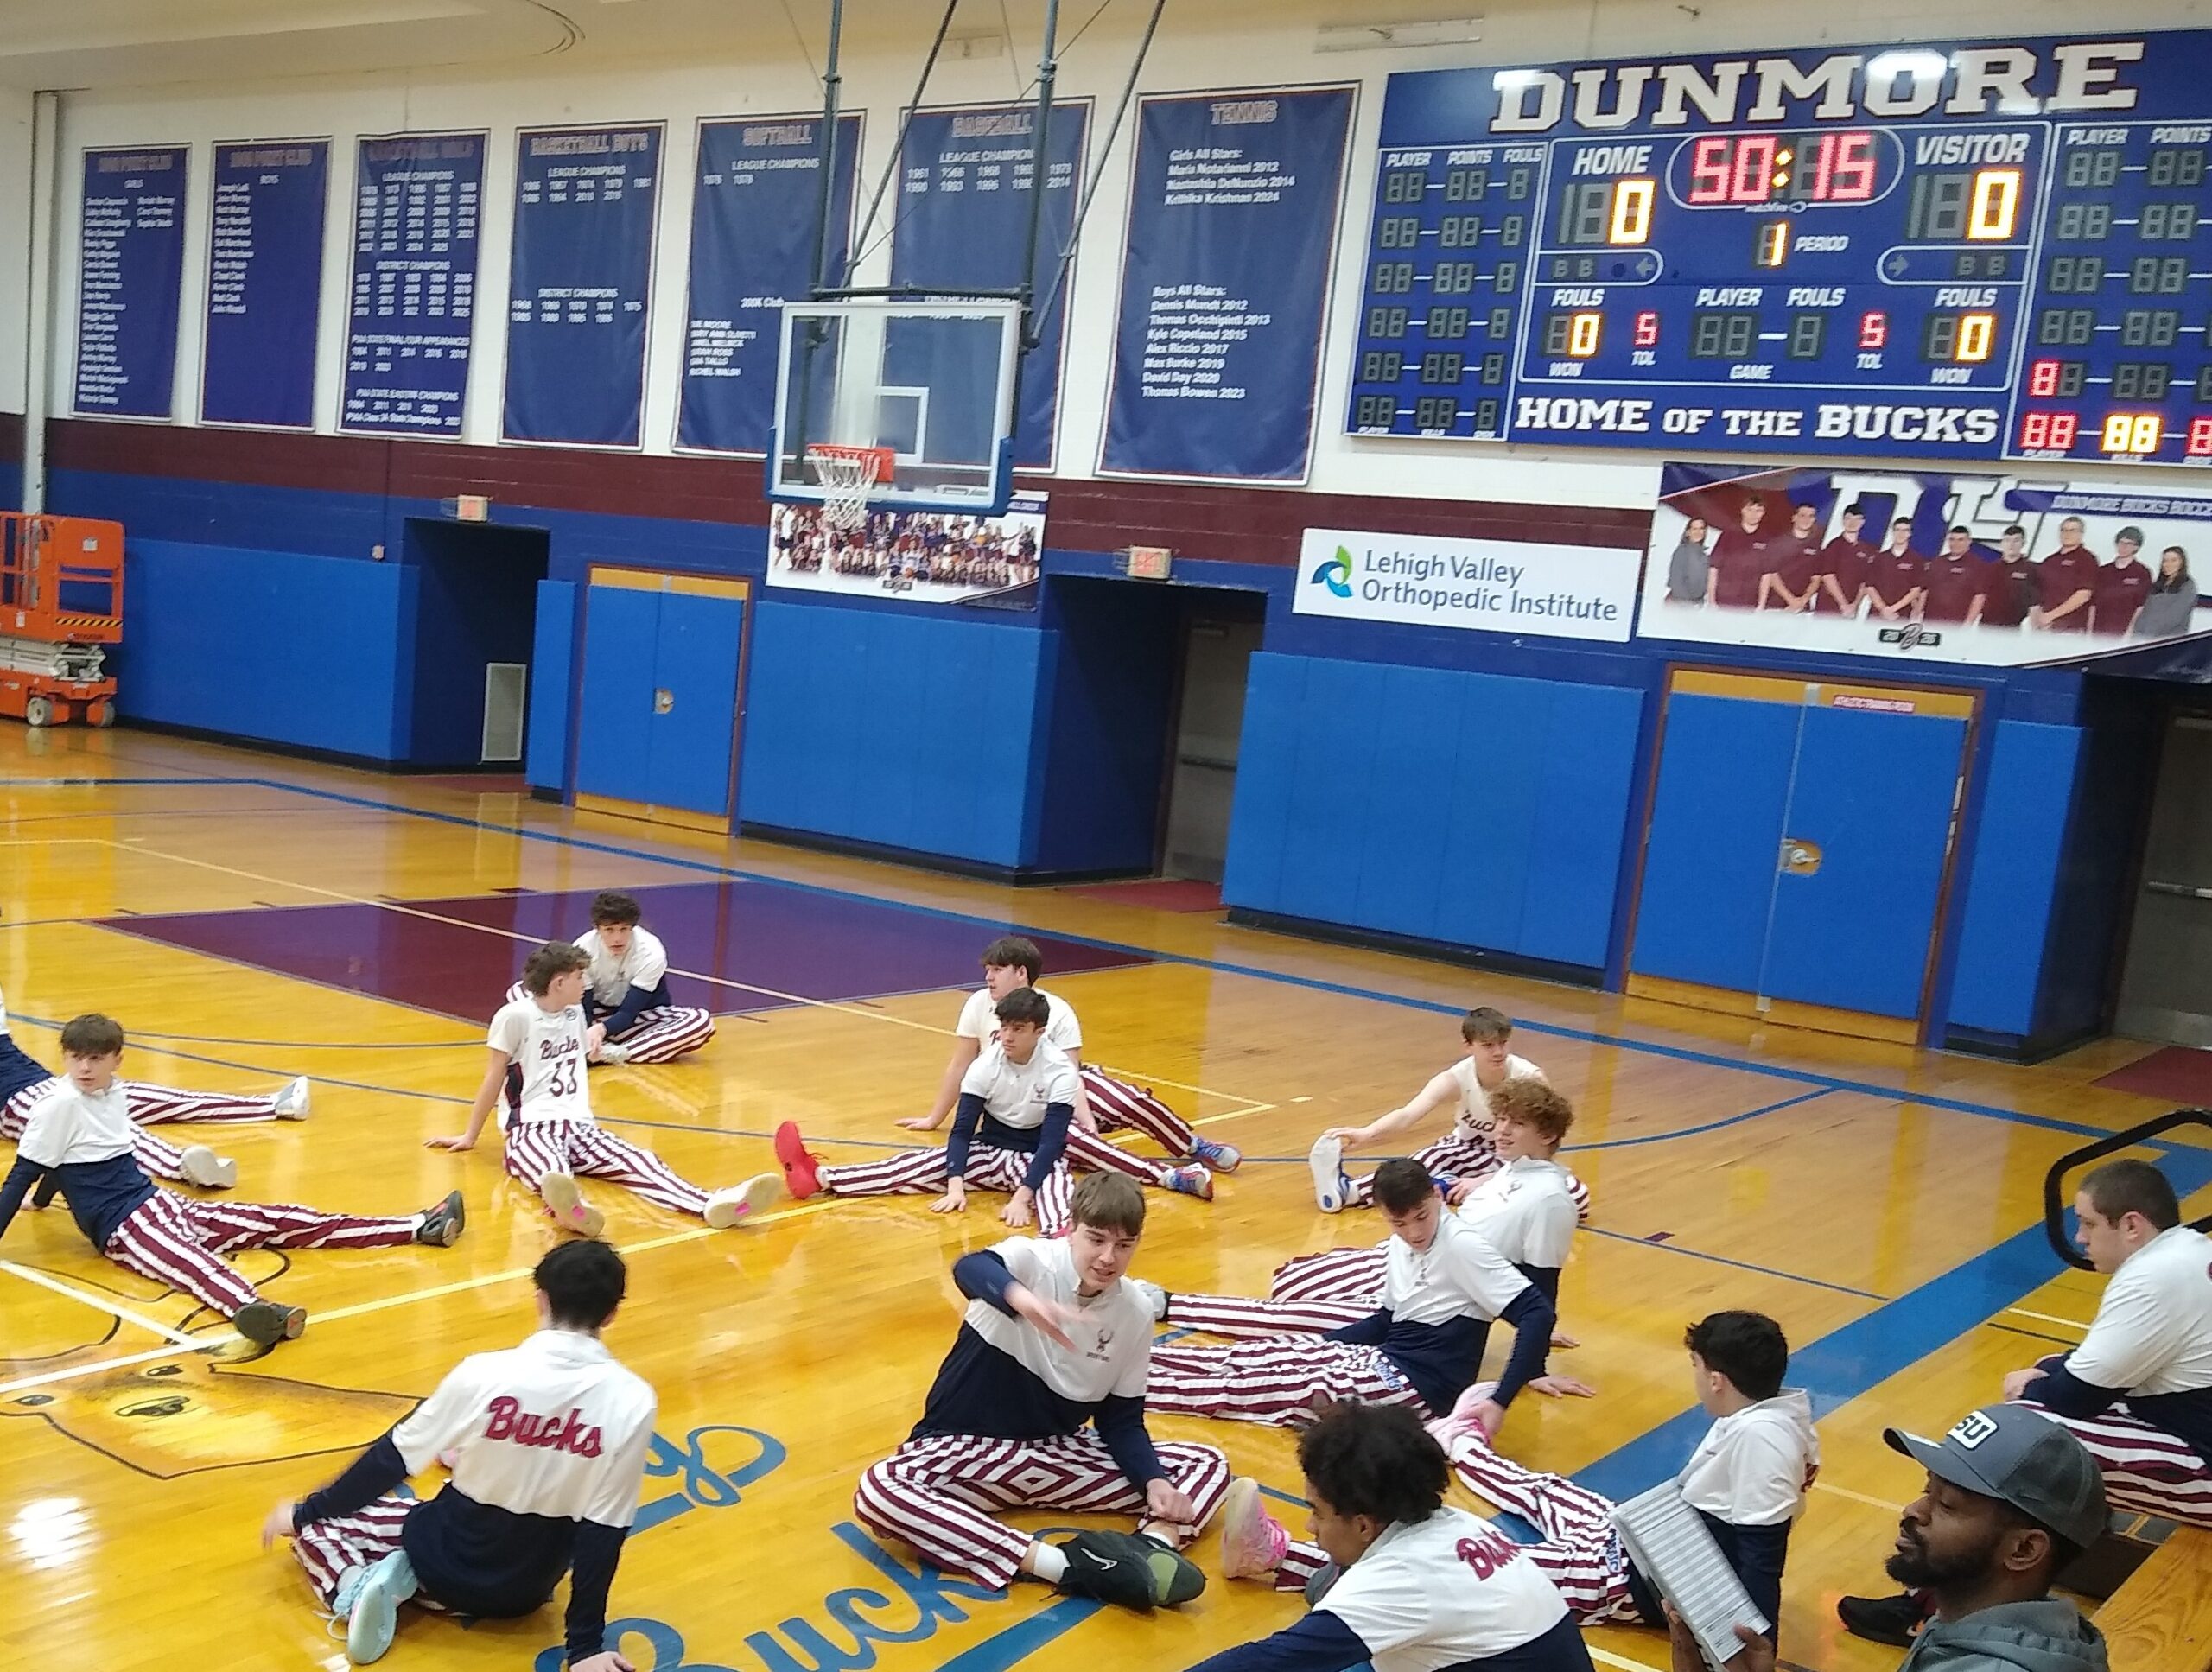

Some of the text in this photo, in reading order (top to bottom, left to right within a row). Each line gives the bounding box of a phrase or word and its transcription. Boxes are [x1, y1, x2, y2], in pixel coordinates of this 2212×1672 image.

[1489, 41, 2145, 132] DUNMORE
[1211, 100, 1278, 124] TENNIS
[2066, 129, 2128, 145] PLAYER
[1503, 148, 1544, 162] FOULS
[1915, 133, 2031, 165] VISITOR
[1386, 151, 1431, 167] PLAYER
[1572, 145, 1653, 175] HOME
[1794, 236, 1849, 251] PERIOD
[1552, 289, 1605, 307] FOULS
[1695, 289, 1763, 307] PLAYER
[1787, 288, 1846, 307] FOULS
[1934, 288, 1998, 307] FOULS
[1631, 351, 1656, 366] TOL
[1856, 353, 1883, 369] TOL
[1549, 363, 1583, 377] WON
[1729, 365, 1773, 379] GAME
[1930, 367, 1973, 384] WON
[1516, 397, 1999, 443] HOME OF THE BUCKS
[1364, 550, 1525, 589] Lehigh Valley
[1363, 579, 1618, 622] Orthopedic Institute
[485, 1395, 602, 1459] Bucks
